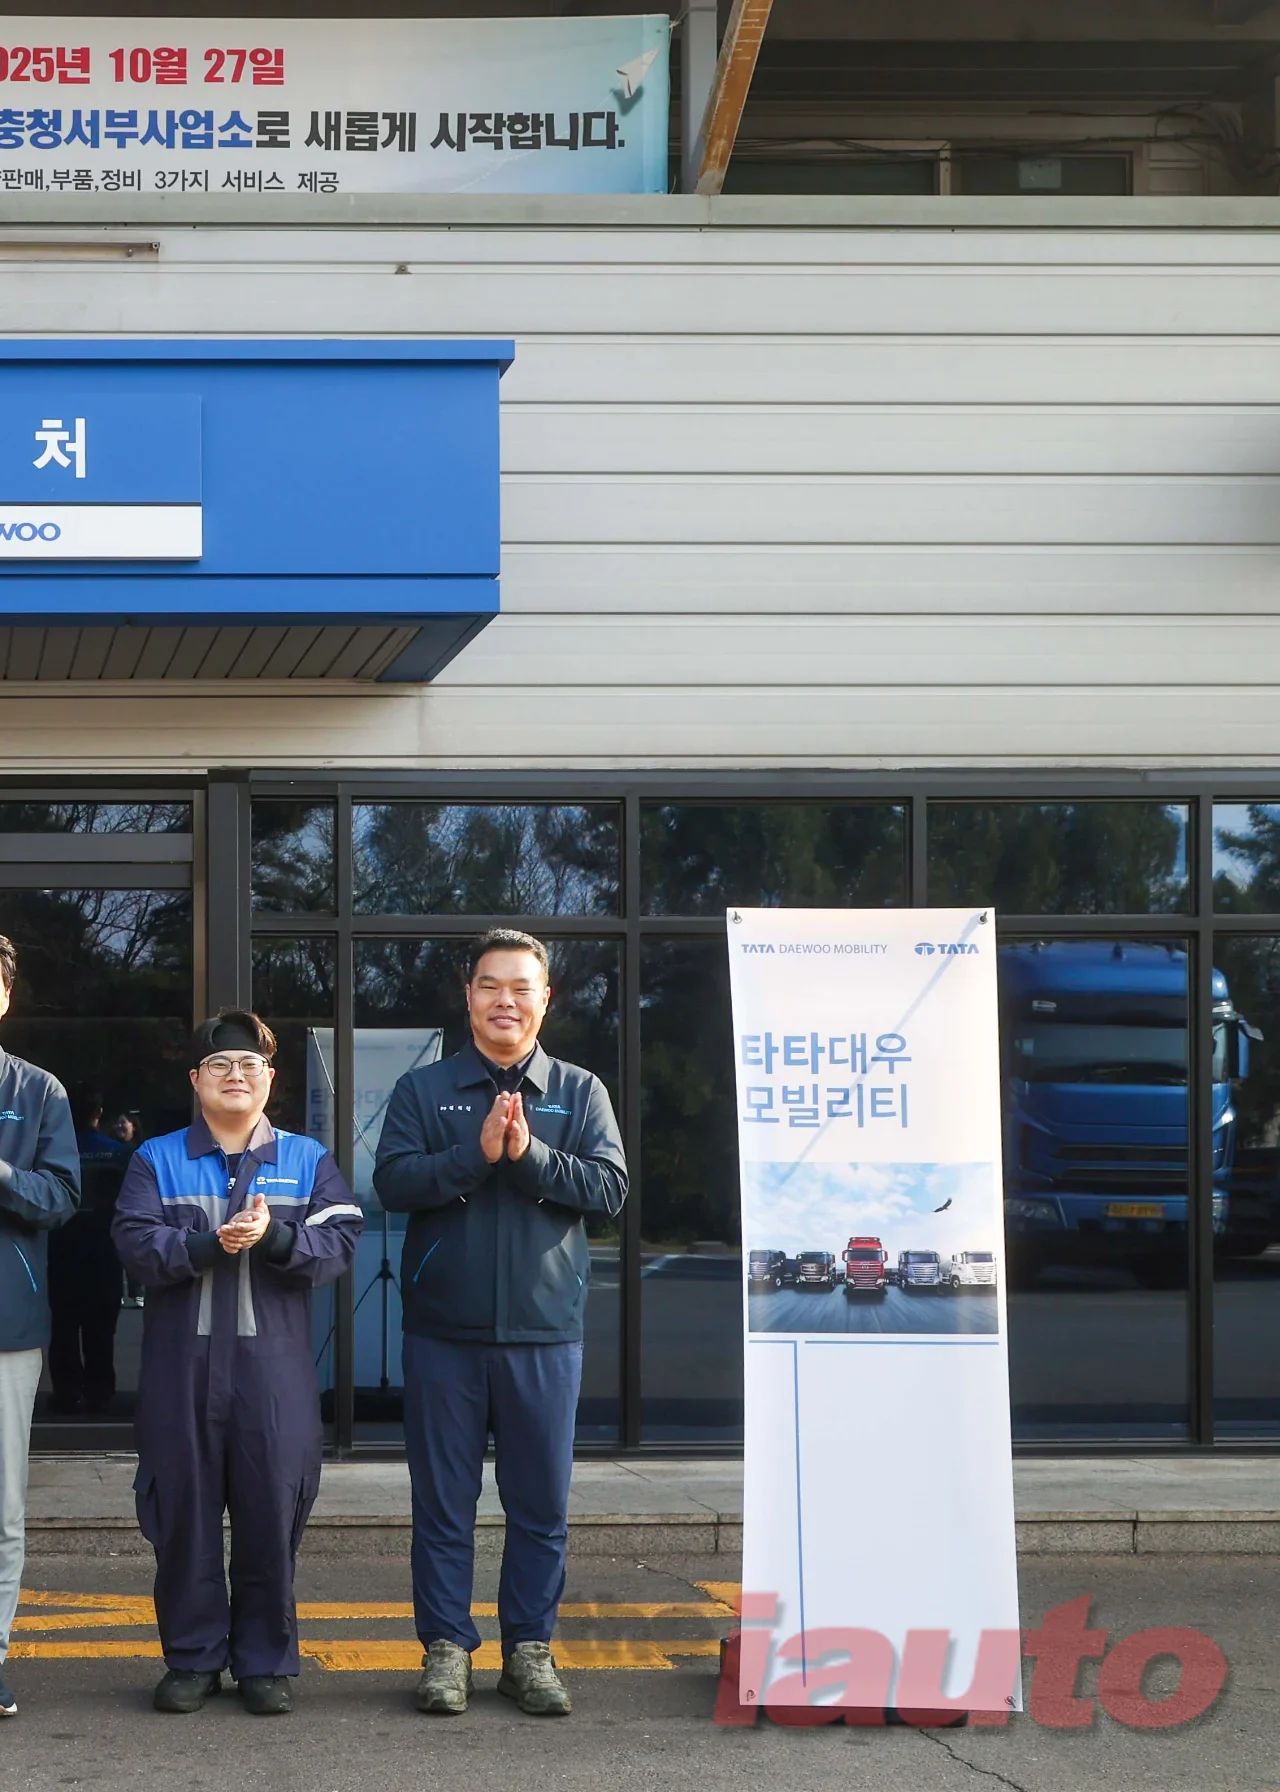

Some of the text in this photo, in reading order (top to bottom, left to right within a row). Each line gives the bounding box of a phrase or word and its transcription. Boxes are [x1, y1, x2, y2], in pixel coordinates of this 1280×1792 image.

[108, 47, 188, 86] 10월
[203, 48, 285, 86] 27일
[304, 110, 417, 153] 새롭게
[429, 110, 626, 153] 시작합니다.
[154, 168, 210, 193] 3가지
[221, 169, 285, 193] 서비스
[296, 170, 340, 194] 제공
[740, 943, 888, 955] TATA DAEWOO MOBILITY
[937, 943, 980, 955] TATA
[741, 1031, 912, 1075] 타타대우
[742, 1083, 909, 1129] 모빌리티
